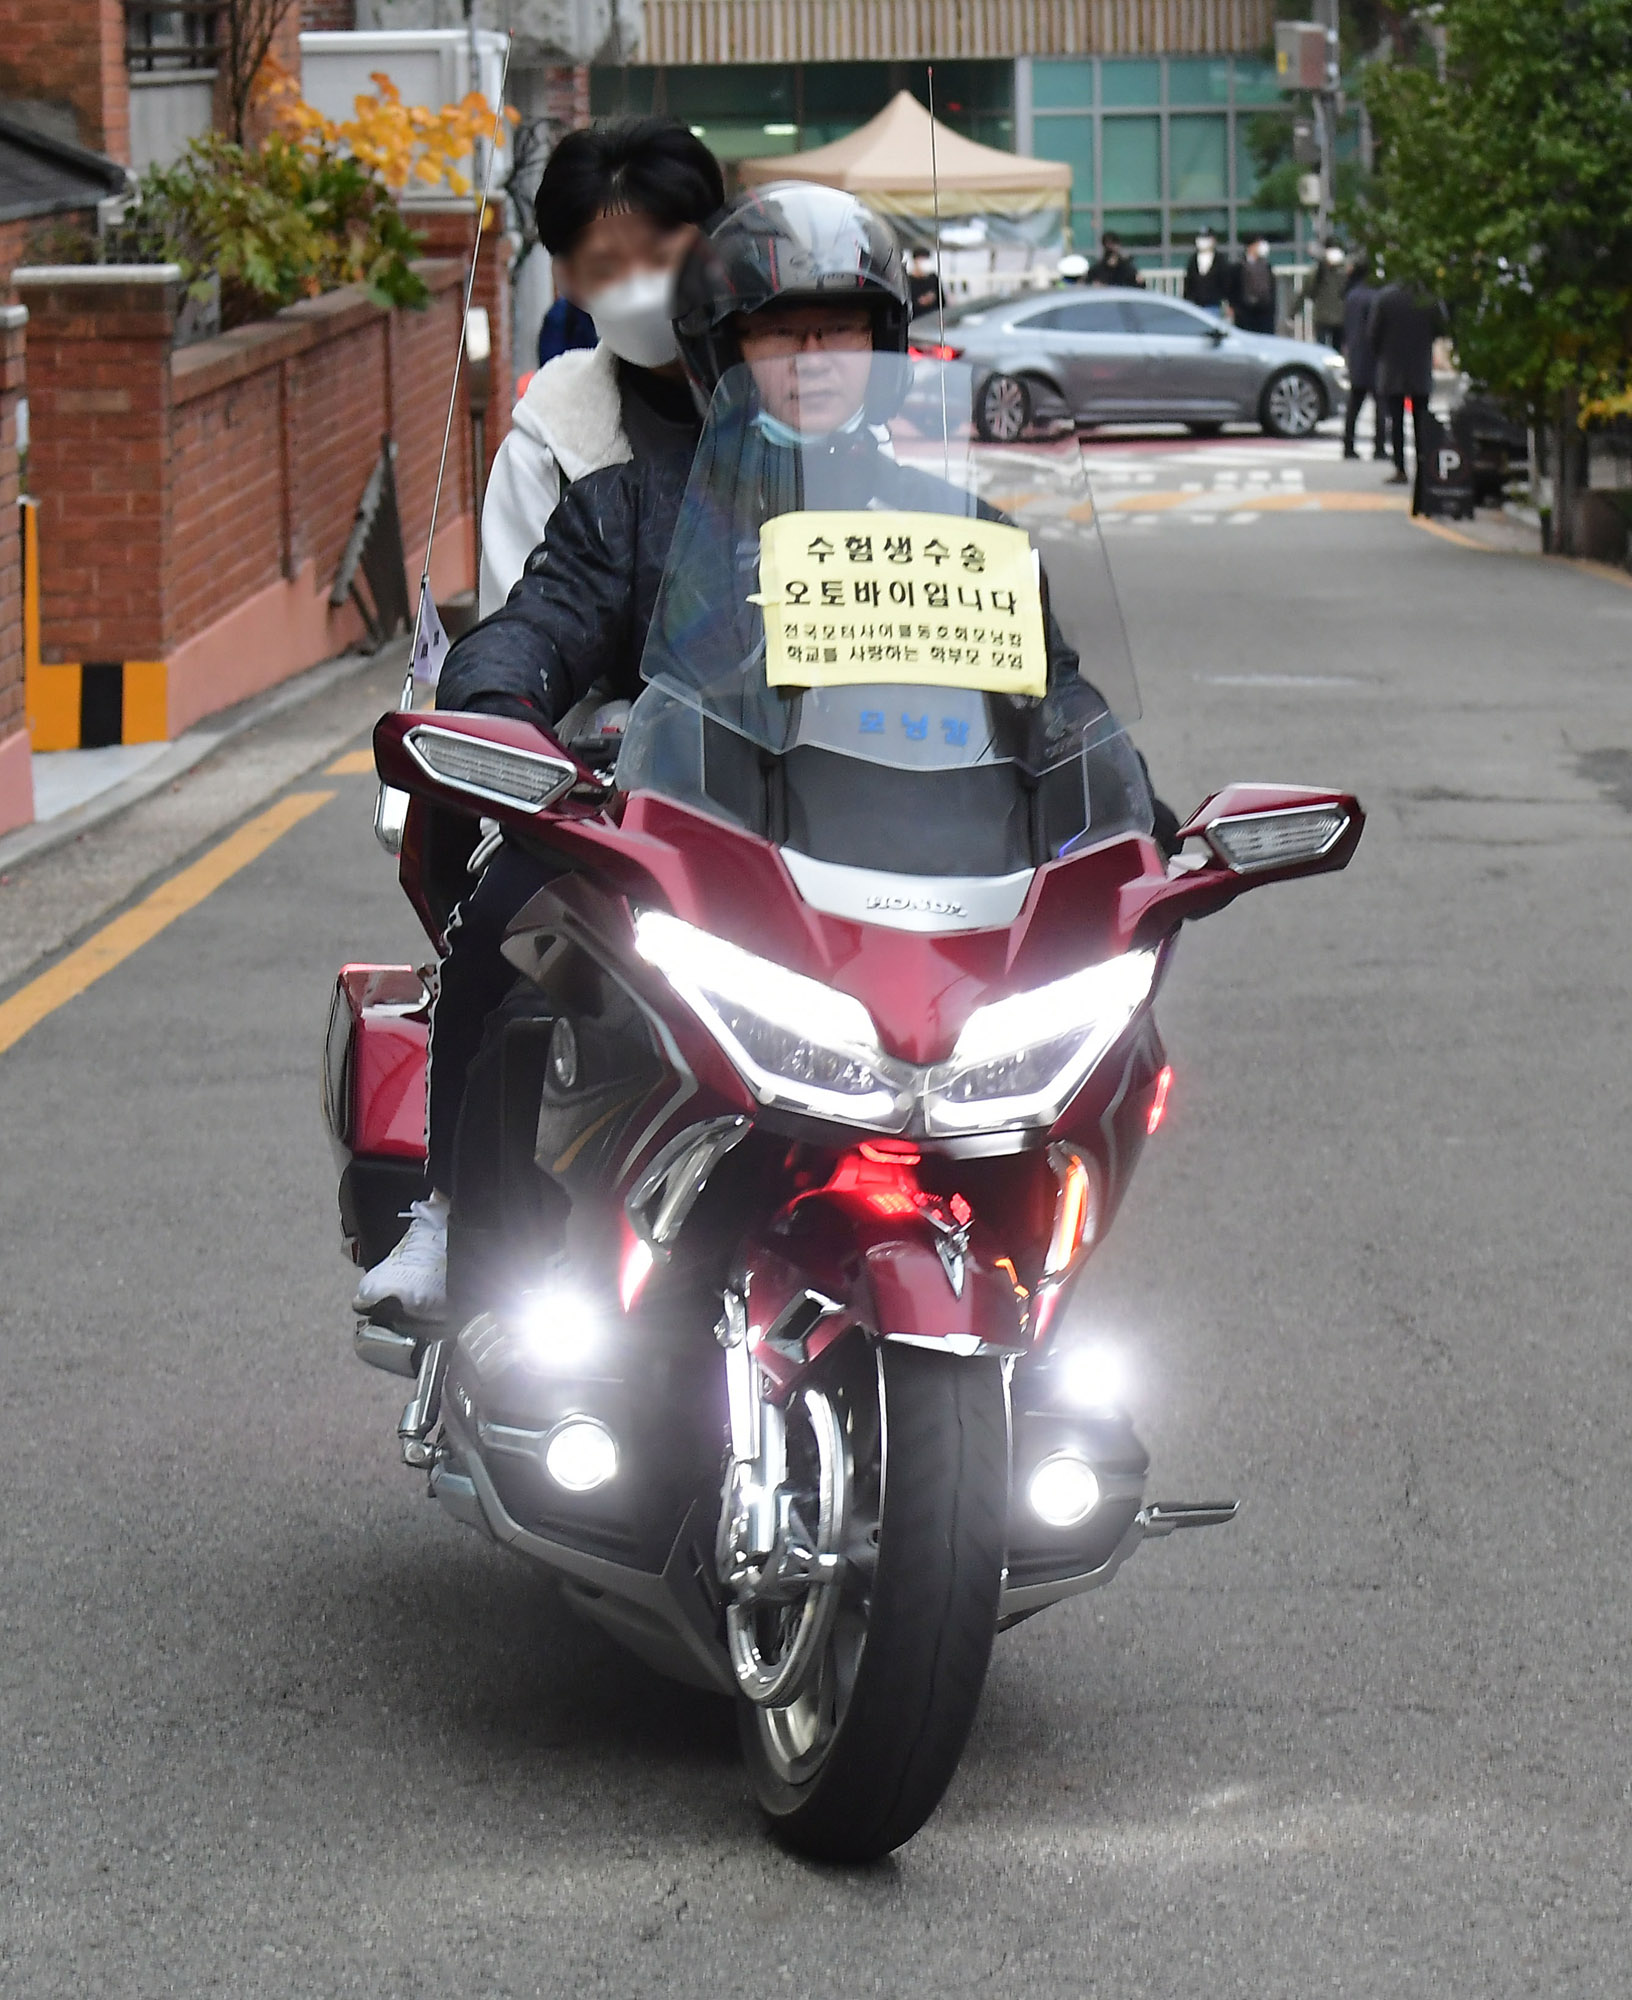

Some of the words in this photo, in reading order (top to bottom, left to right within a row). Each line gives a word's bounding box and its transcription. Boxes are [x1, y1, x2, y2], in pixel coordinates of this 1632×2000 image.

[1438, 449, 1461, 480] P
[807, 535, 986, 573] 수험생수송
[784, 579, 1017, 615] 오토바이입니다
[849, 645, 918, 663] 사랑하는
[930, 645, 981, 666] 학부모
[866, 895, 968, 918] HONDA
